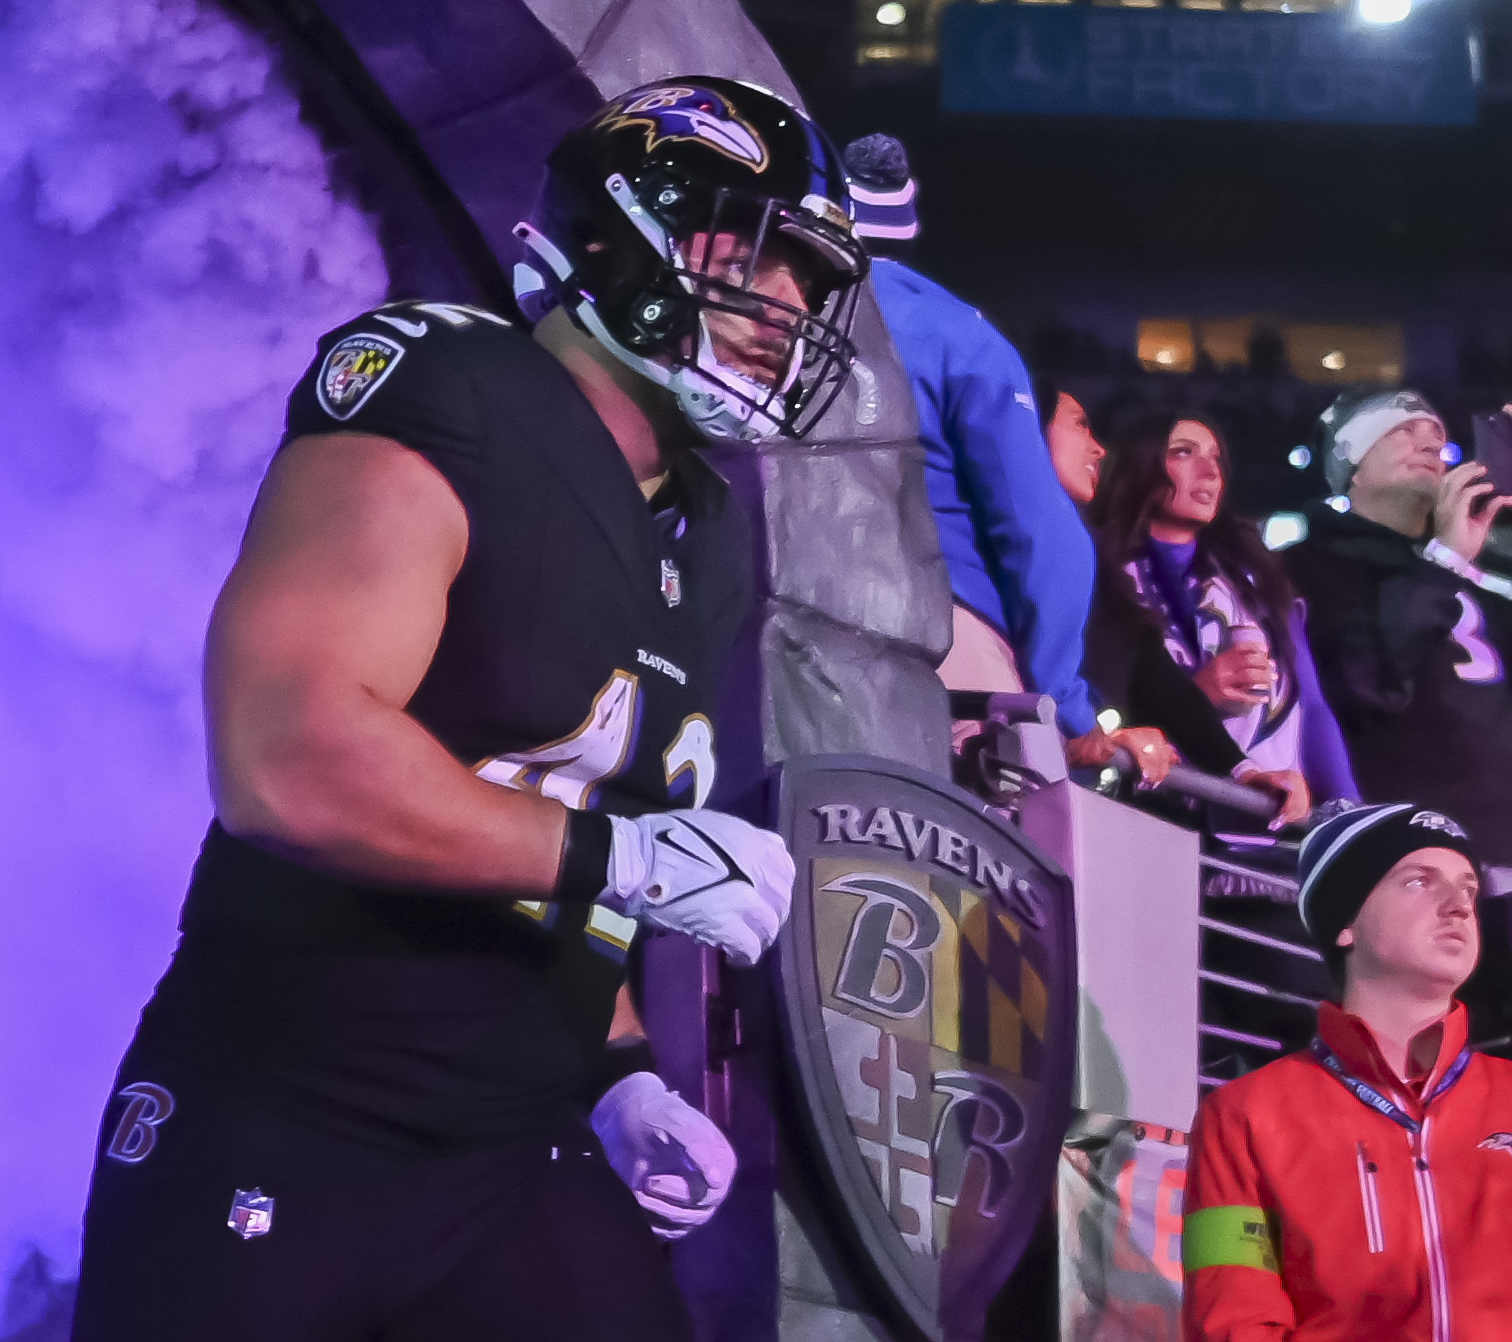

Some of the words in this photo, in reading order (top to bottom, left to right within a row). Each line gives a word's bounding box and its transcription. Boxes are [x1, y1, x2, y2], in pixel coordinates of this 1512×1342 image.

[1086, 60, 1435, 114] FACTORY
[636, 647, 687, 686] RAVENS
[811, 802, 1047, 932] RAVENS
[818, 871, 942, 1020] B
[105, 1080, 176, 1164] B
[931, 1069, 1025, 1219] R
